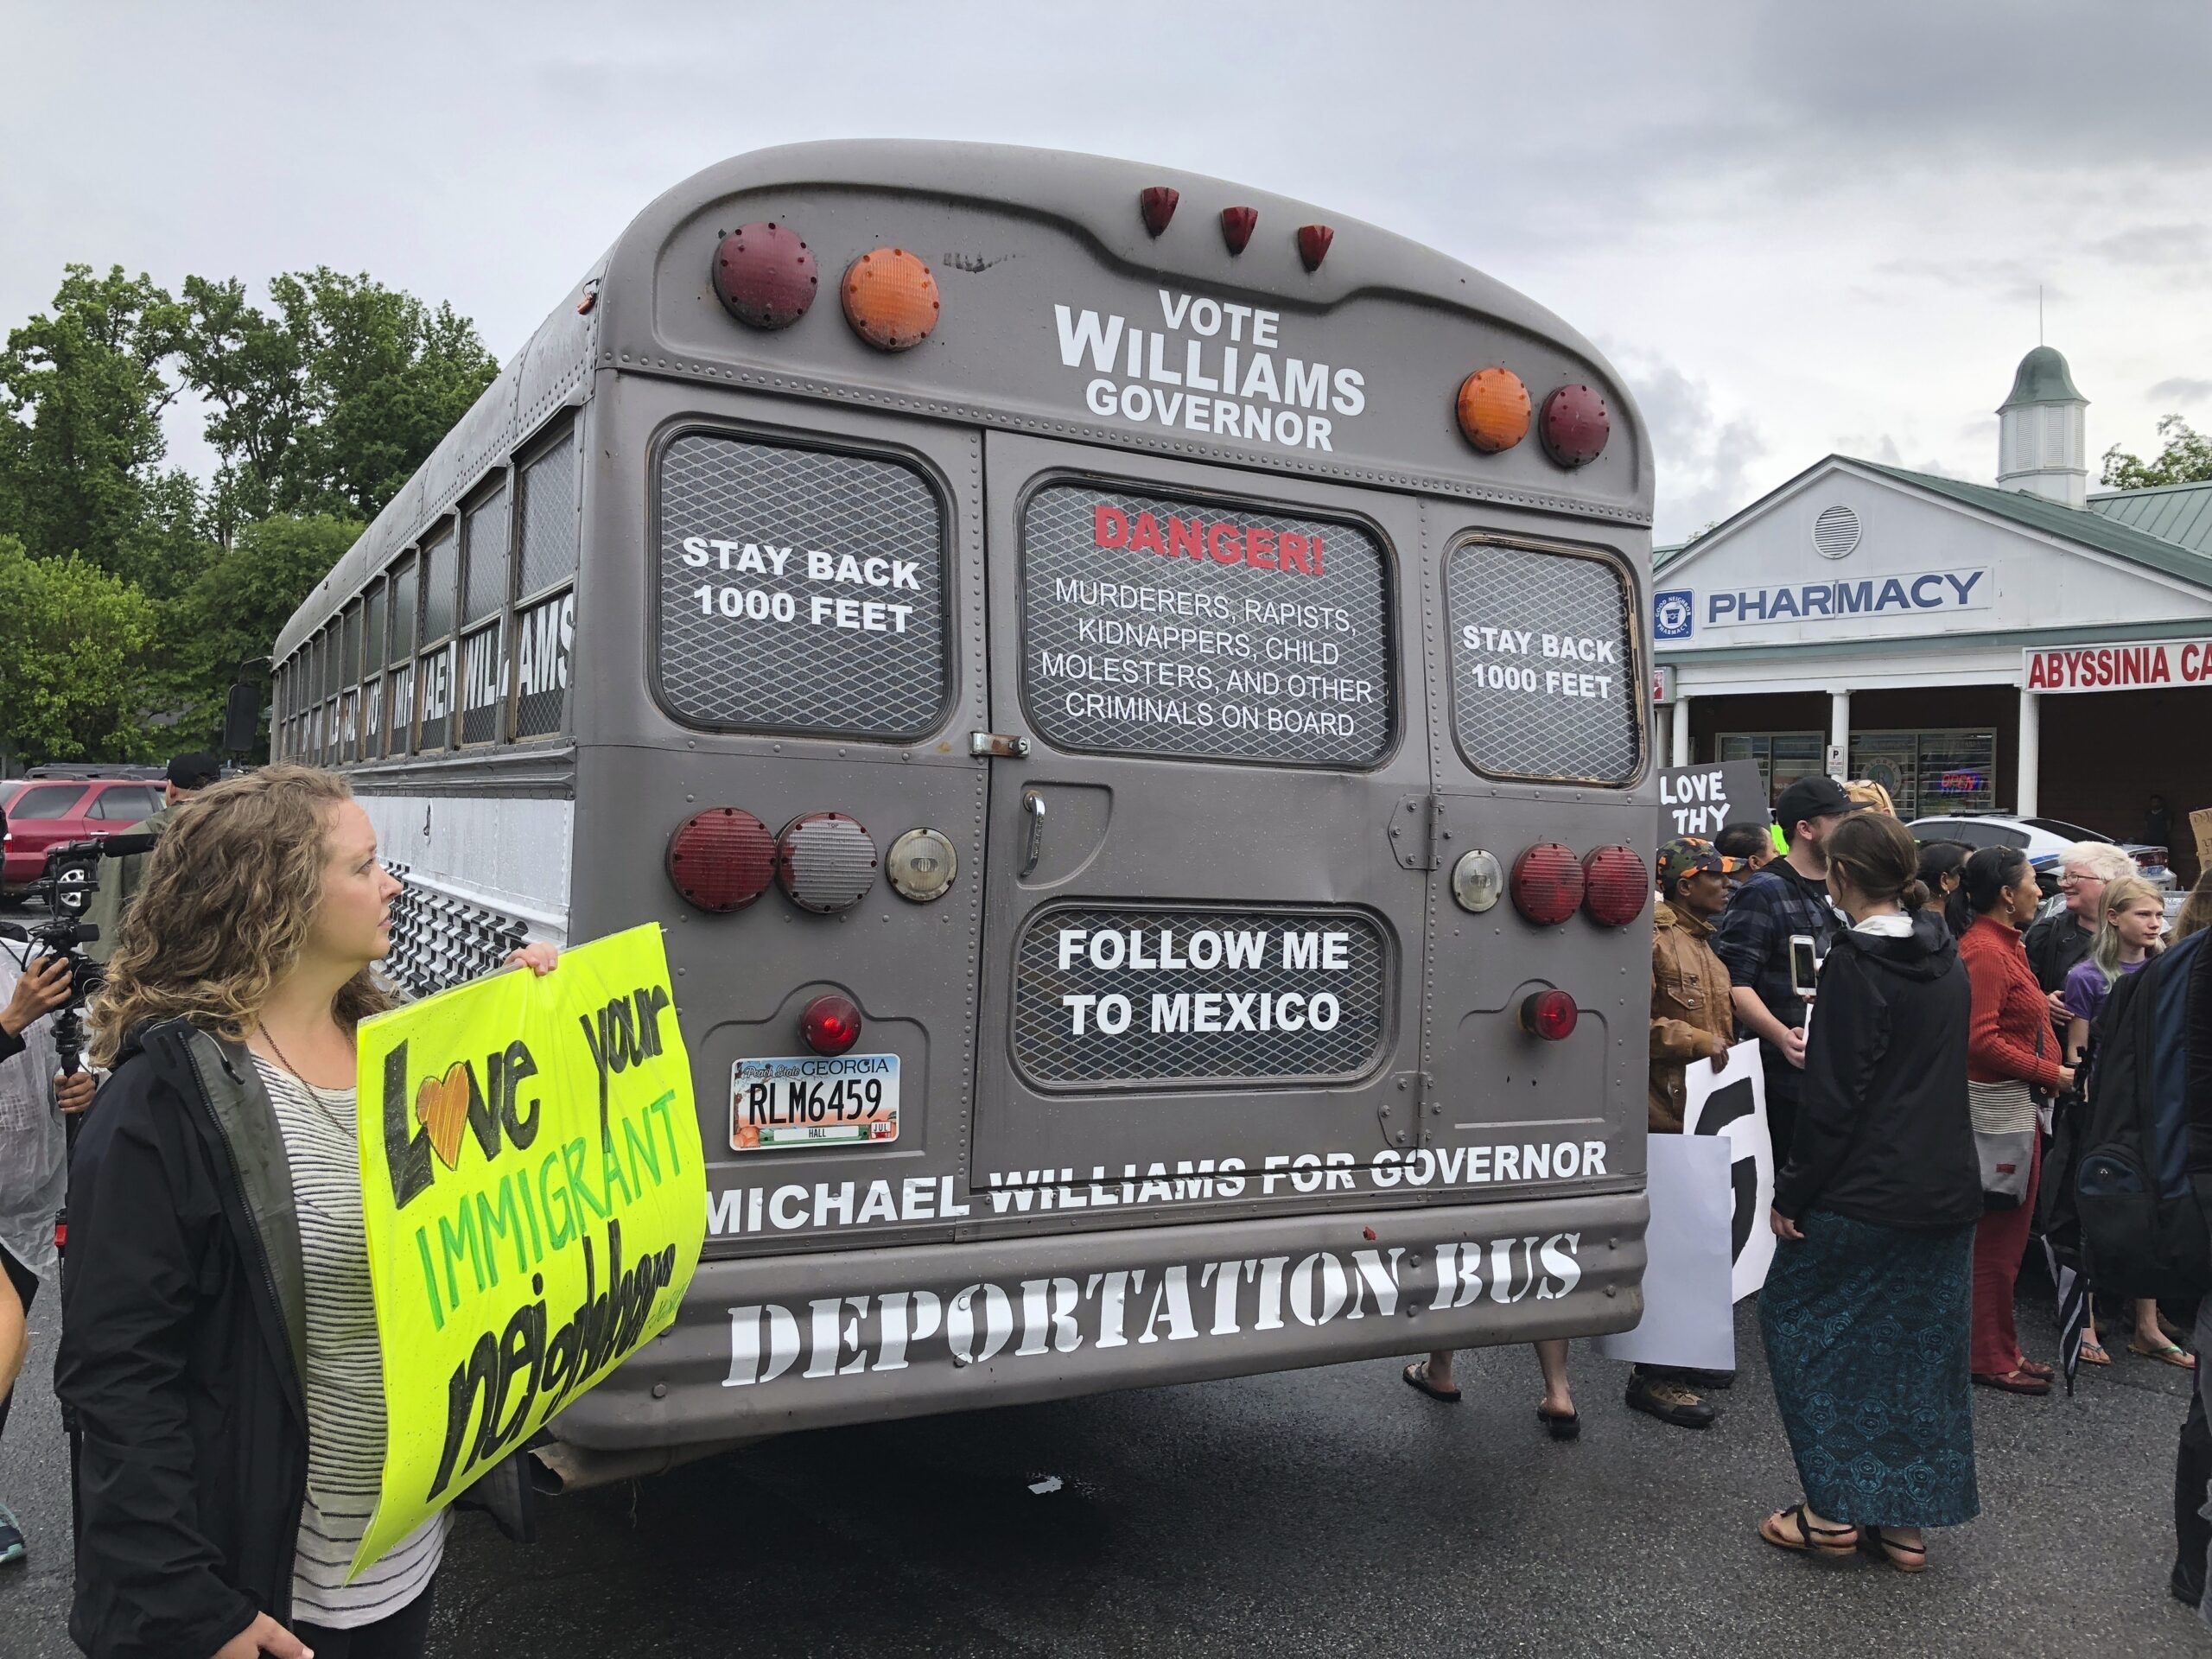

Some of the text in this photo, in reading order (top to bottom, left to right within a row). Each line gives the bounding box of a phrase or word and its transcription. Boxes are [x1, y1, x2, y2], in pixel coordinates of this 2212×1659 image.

[1159, 289, 1280, 348] VOTE
[1054, 304, 1365, 416] WILLIAMS
[1086, 378, 1333, 452] GOVERNOR
[682, 537, 921, 590] STAY BACK
[1094, 505, 1325, 575] DANGER!
[694, 584, 912, 633] 1000 FEET
[1056, 577, 1356, 636] MURDERERS, RAPISTS,
[1655, 600, 1667, 617] GOOD
[1708, 571, 1984, 623] PHARMACY
[1078, 618, 1339, 665] KIDNAPPERS, CHILD
[1463, 625, 1616, 664] STAY BACK
[1656, 623, 1688, 635] PHARMACY
[1042, 652, 1373, 704] MOLESTERS, AND OTHER
[1471, 664, 1611, 699] 1000 FEET
[2028, 646, 2171, 689] ABYSSINIA
[1065, 691, 1355, 736] CRIMINALS ON BOARD
[1660, 770, 1726, 805] LOVE
[1672, 803, 1731, 835] THY
[1058, 929, 1349, 970] FOLLOW ME
[1063, 992, 1340, 1035] TO MEXICO
[579, 985, 670, 1154] your
[743, 1058, 889, 1078] Peach State GEORGIA
[749, 1078, 881, 1125] RLM6459
[808, 1123, 888, 1139] HALL JUL
[416, 1090, 681, 1332] IMMIGRANT
[706, 1140, 1607, 1236] MICHAEL WILLIAMS FOR GOVERNOR
[721, 1232, 1581, 1387] DEPORTATION BUS
